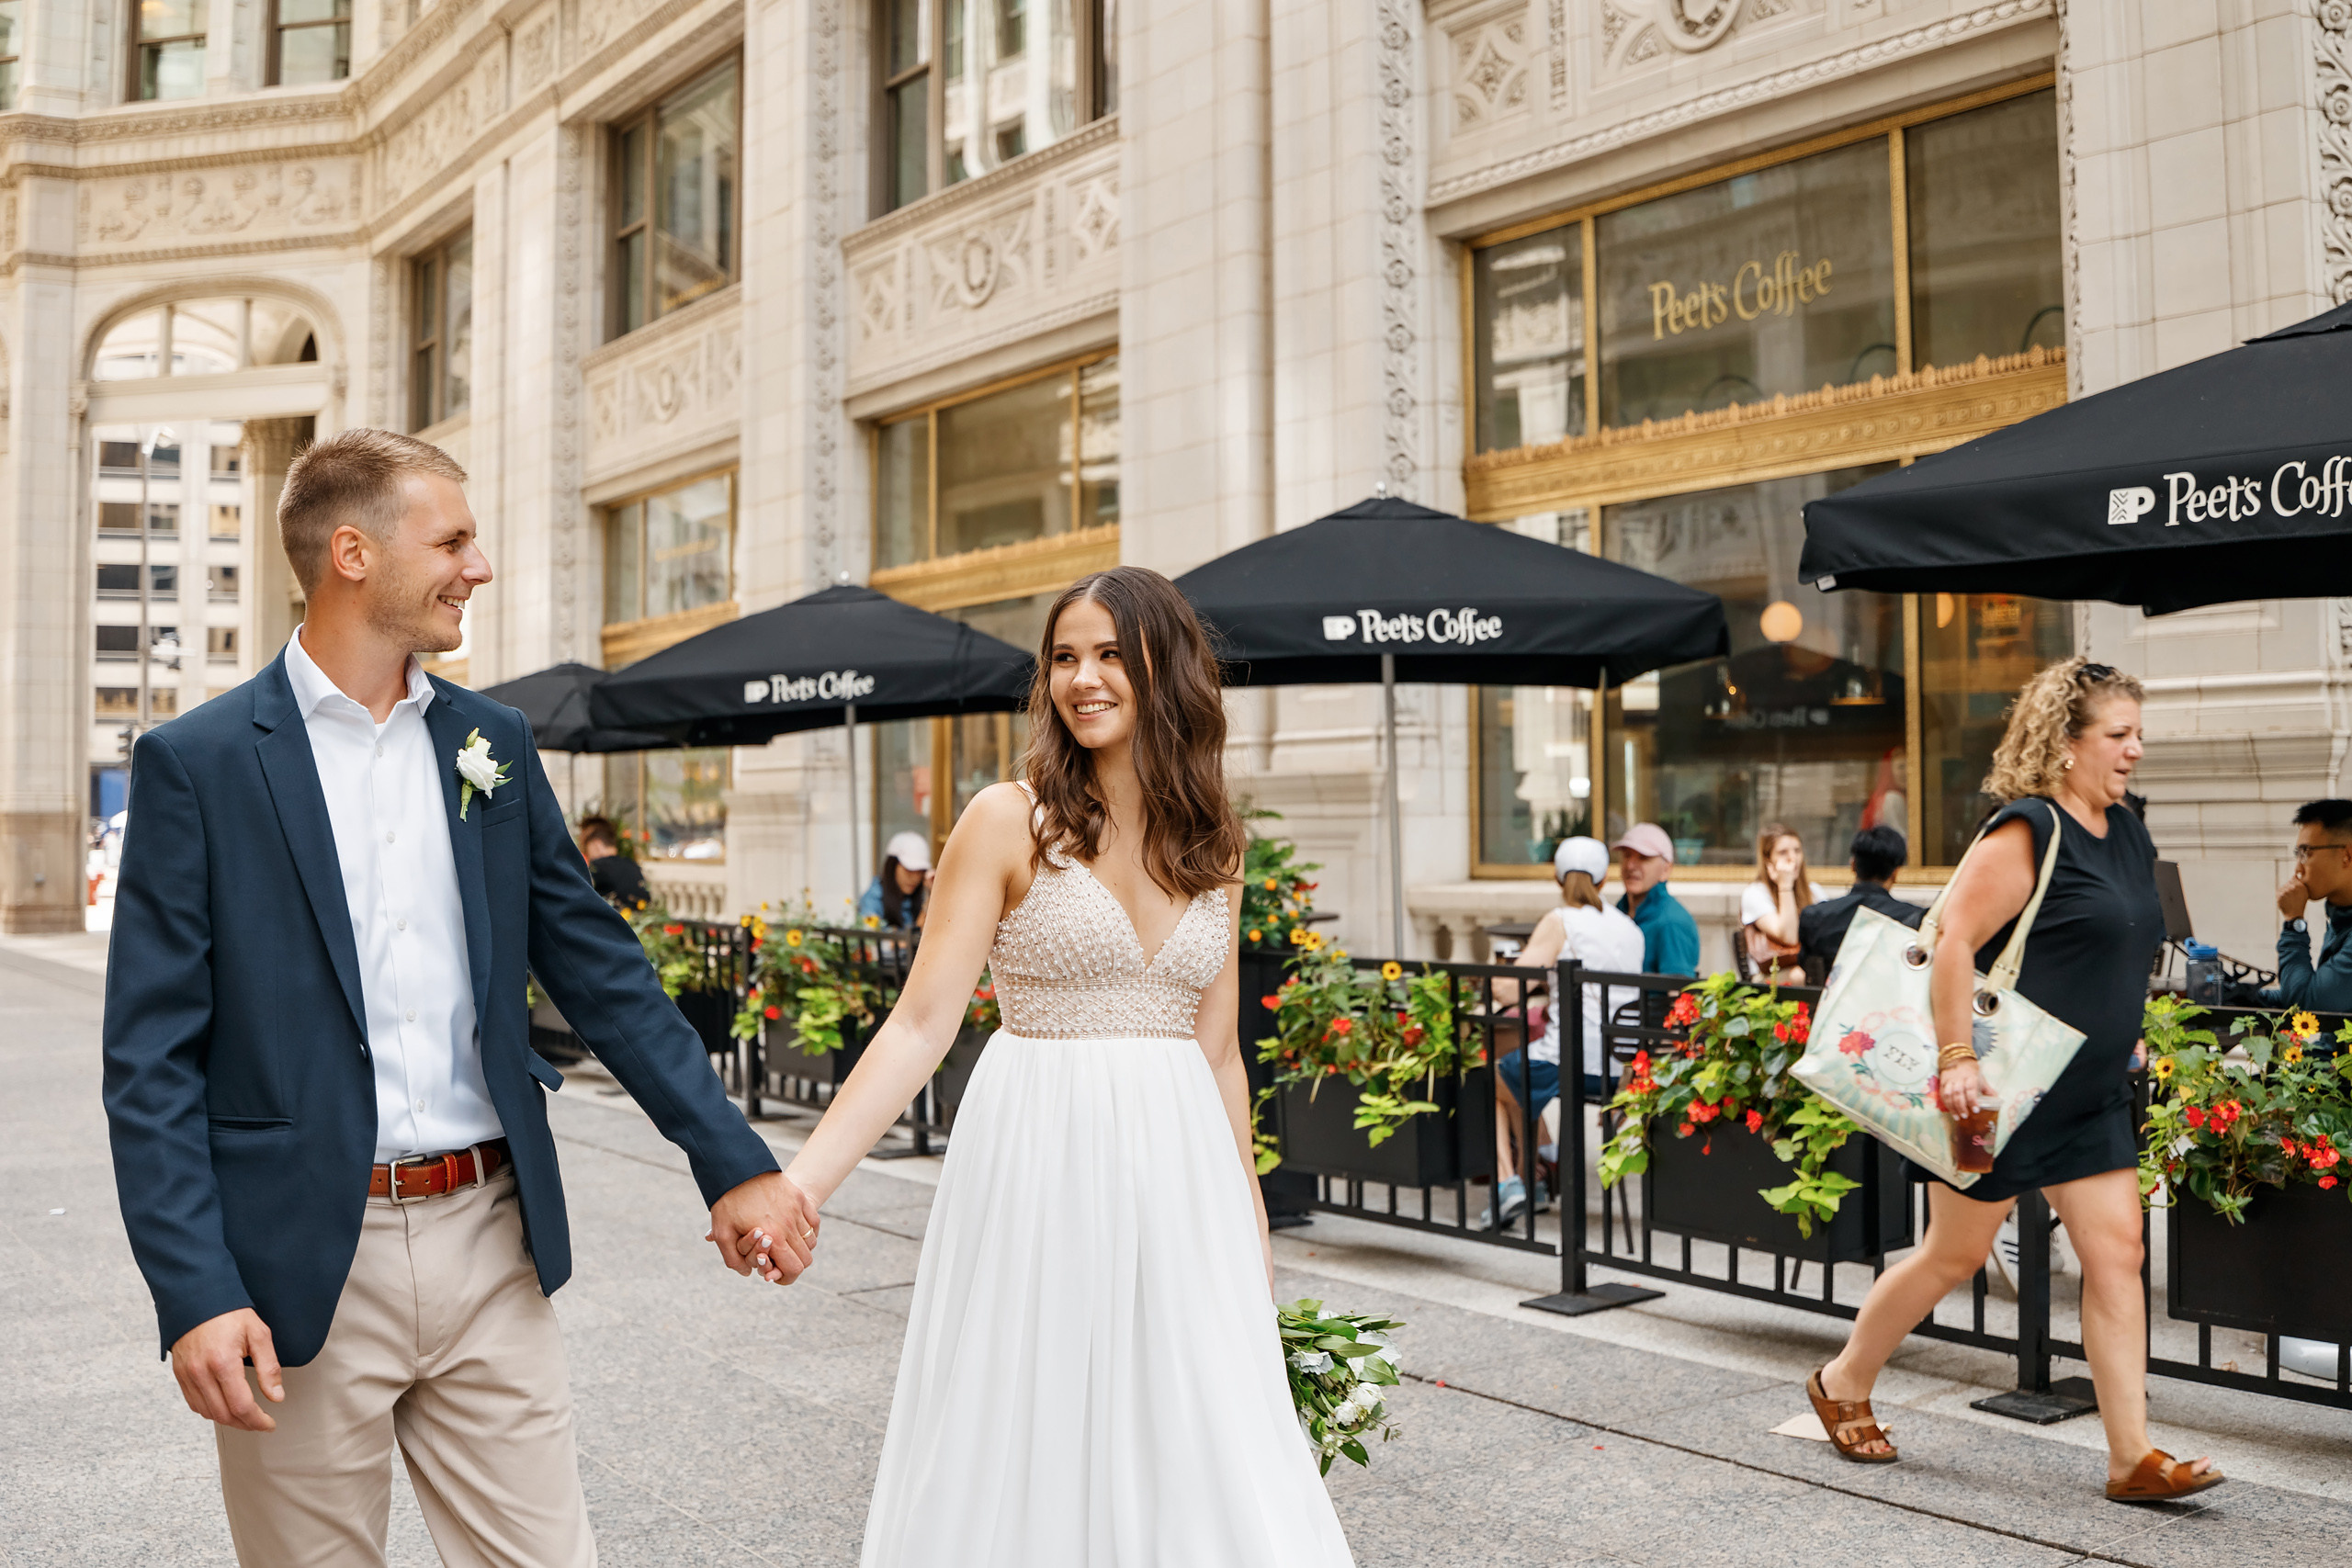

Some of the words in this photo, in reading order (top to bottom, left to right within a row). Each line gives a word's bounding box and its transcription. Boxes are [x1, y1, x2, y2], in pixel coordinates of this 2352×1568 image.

[1648, 280, 1728, 341] Peet's
[1734, 250, 1833, 321] Coffee
[2163, 471, 2262, 526] Peet's
[2270, 456, 2352, 517] Coff
[1356, 609, 1424, 644] Peet's
[1426, 607, 1503, 645] Coffee
[818, 670, 875, 701] Coffee
